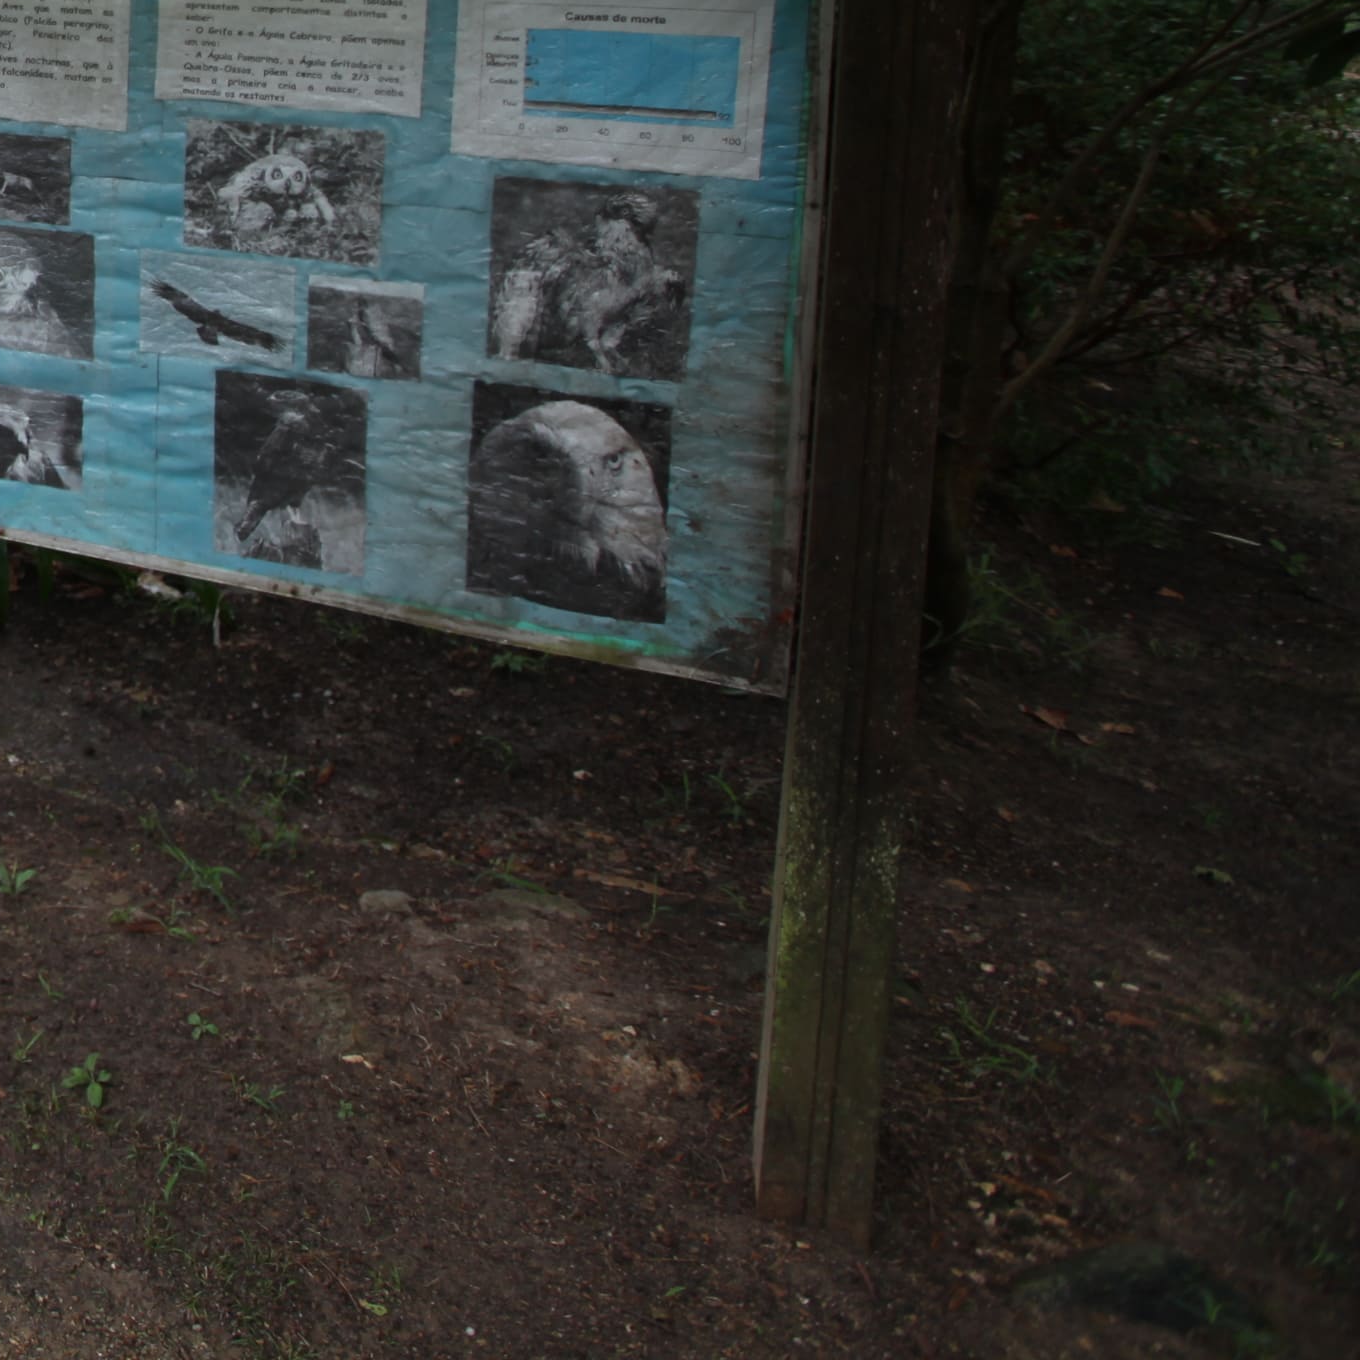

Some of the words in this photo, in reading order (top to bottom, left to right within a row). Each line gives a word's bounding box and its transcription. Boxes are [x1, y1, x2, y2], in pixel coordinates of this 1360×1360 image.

[565, 12, 609, 23] Causas
[613, 14, 626, 24] de
[631, 14, 666, 25] morte
[83, 60, 99, 71] que
[352, 72, 369, 82] 2/3
[555, 126, 568, 134] 20
[722, 137, 741, 146] 100
